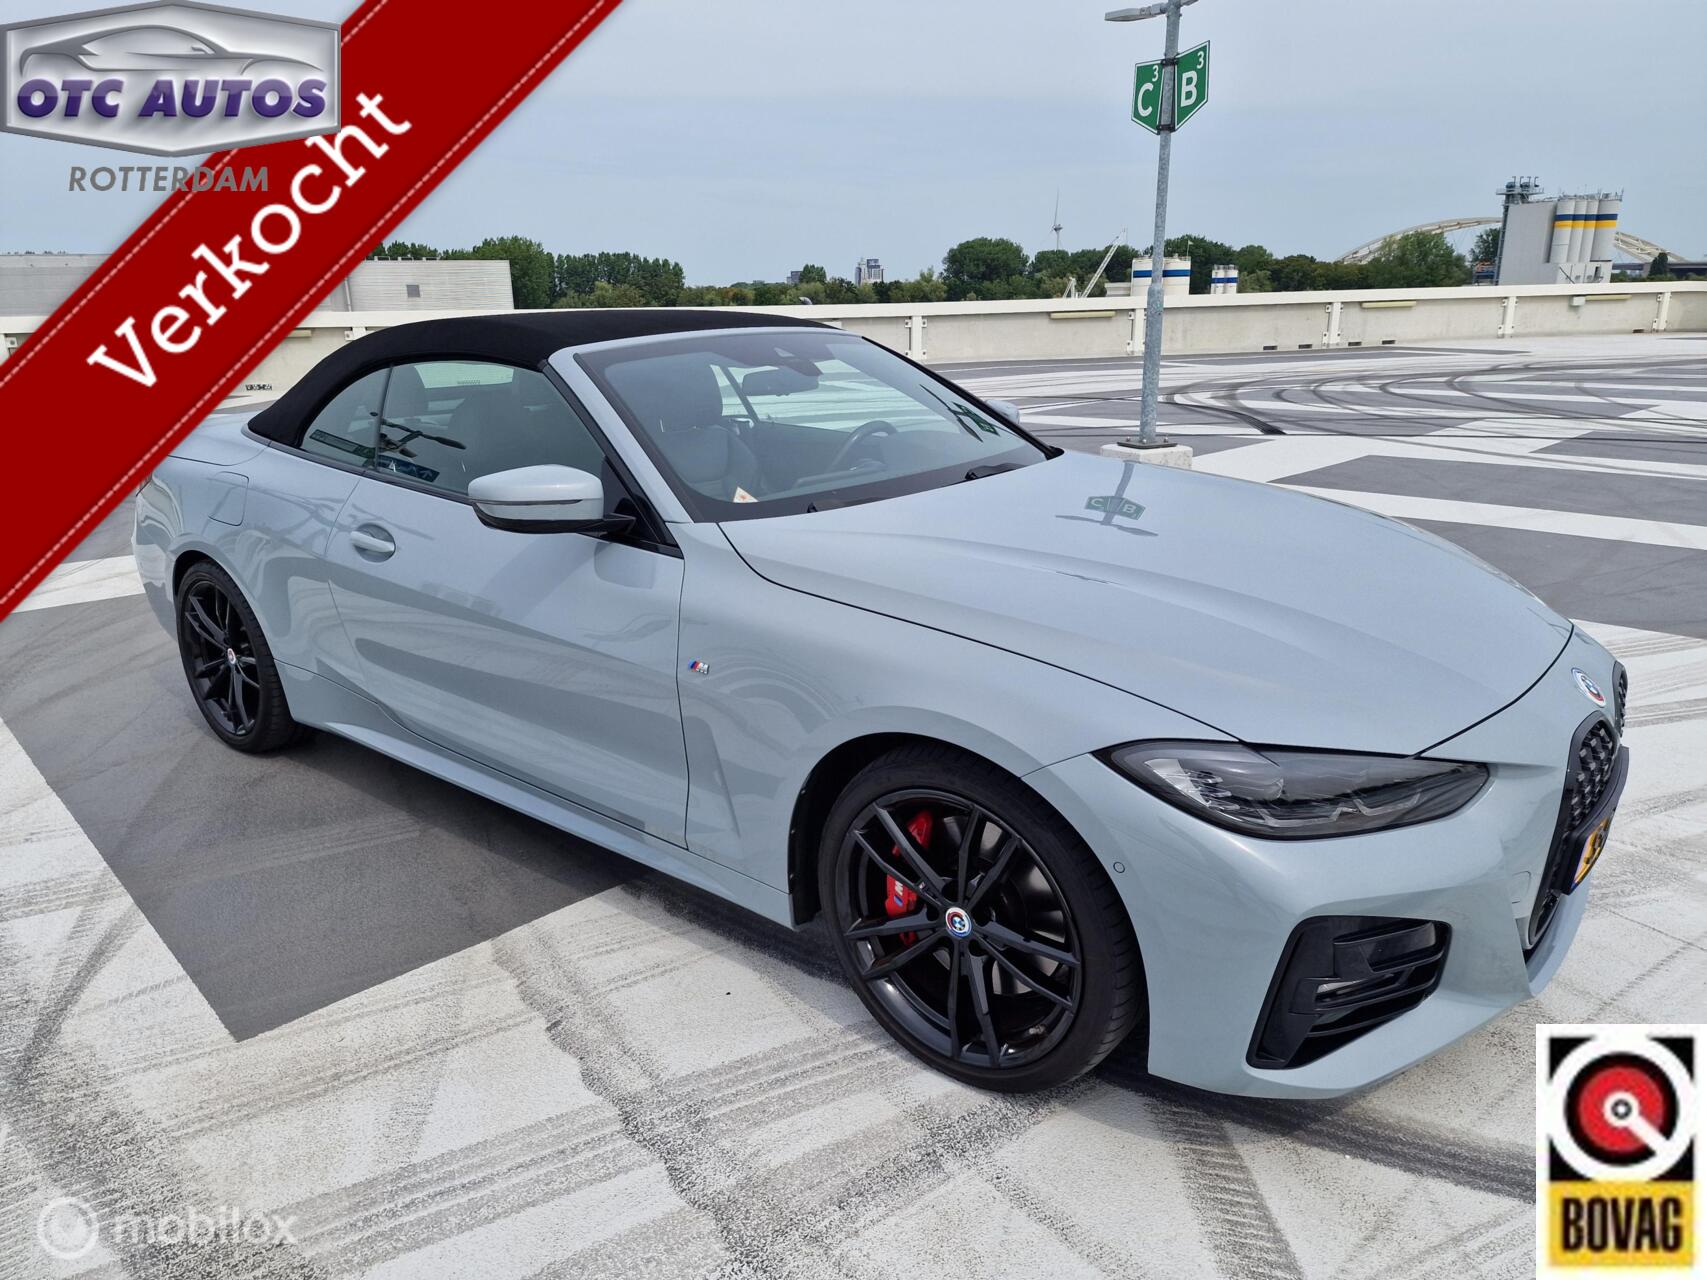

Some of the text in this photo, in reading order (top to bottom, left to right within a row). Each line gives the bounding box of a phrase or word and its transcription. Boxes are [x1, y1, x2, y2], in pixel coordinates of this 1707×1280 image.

[1197, 51, 1204, 69] 3
[1152, 65, 1159, 82] 3
[1137, 82, 1154, 117] C
[1180, 70, 1198, 107] B
